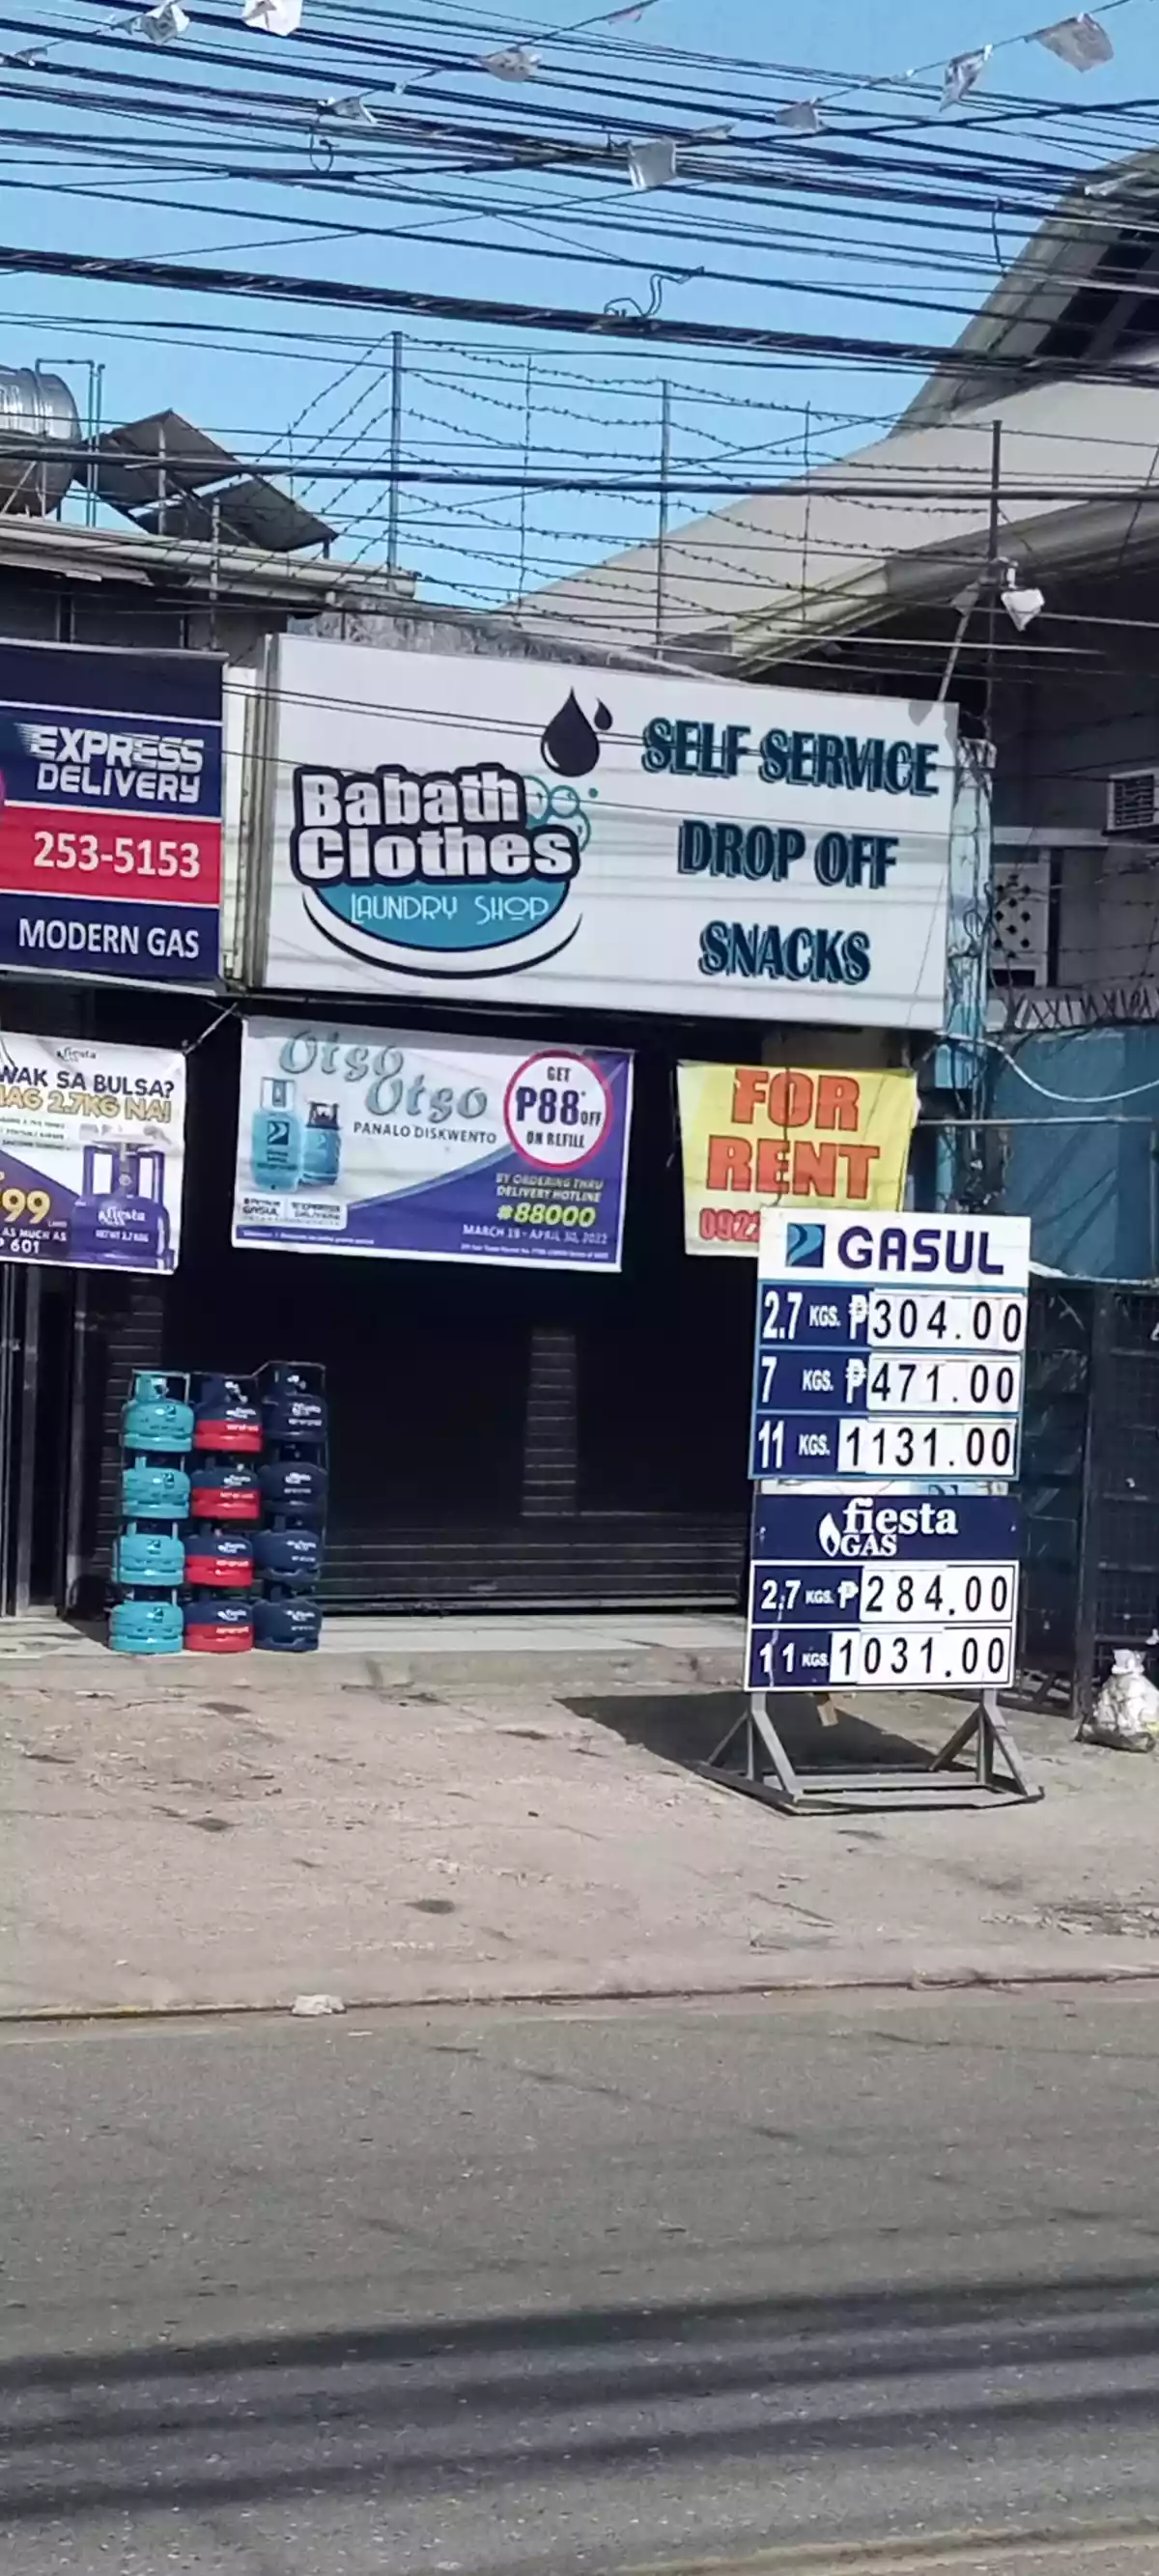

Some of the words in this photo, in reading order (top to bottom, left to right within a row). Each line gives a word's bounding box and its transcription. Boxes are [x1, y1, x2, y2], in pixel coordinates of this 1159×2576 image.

[25, 723, 205, 774] EXPRESS
[642, 718, 750, 776] SELF
[758, 728, 940, 796] SERVICE
[37, 763, 201, 804] DELIVERY
[299, 769, 521, 827] Babath
[33, 831, 201, 879] 253-5153
[297, 827, 574, 880] Clothes
[678, 818, 806, 881] DROP
[814, 832, 899, 890] OFF
[351, 892, 458, 924] LAUNDRY
[474, 894, 550, 924] SHOP
[18, 918, 140, 955] MODERN
[147, 926, 200, 960] GAS
[698, 920, 871, 985] SNACKS
[279, 1029, 404, 1083] Otso
[547, 1065, 571, 1083] GET
[56, 1070, 87, 1091] SA
[93, 1074, 175, 1100] BULSA?
[365, 1074, 489, 1124] Otso
[731, 1067, 861, 1131] FOR
[47, 1090, 121, 1118] 2.7KG
[125, 1097, 172, 1124] NA!
[580, 1111, 601, 1127] OFF
[353, 1121, 410, 1139] PANALO
[413, 1124, 497, 1145] DISKWENTO
[526, 1131, 543, 1146] ON
[547, 1132, 584, 1148] REFILL
[706, 1135, 881, 1200] RENT
[496, 1185, 551, 1200] DELIVERY
[552, 1190, 602, 1203] HOTLINE
[2, 1226, 16, 1238] AS
[19, 1228, 50, 1240] MUCH
[52, 1231, 67, 1243] AS
[463, 1224, 504, 1238] MARCH
[529, 1230, 560, 1242] APRIL
[496, 1203, 596, 1228] #88000
[10, 1237, 40, 1255] 601
[838, 1225, 1004, 1275] GASUL
[762, 1290, 804, 1340] 2.7
[808, 1304, 841, 1328] KGS.
[760, 1355, 777, 1403] 7
[802, 1369, 834, 1392] KGS.
[758, 1420, 784, 1469] 11
[798, 1433, 831, 1457] KGS.
[846, 1426, 1011, 1467] 1131.00
[842, 1497, 959, 1536] fiesta
[839, 1534, 898, 1557] GAS
[761, 1579, 802, 1611] 2.7
[805, 1589, 834, 1605] KGS.
[759, 1643, 796, 1675] 11
[838, 1636, 1005, 1679] 1031.00
